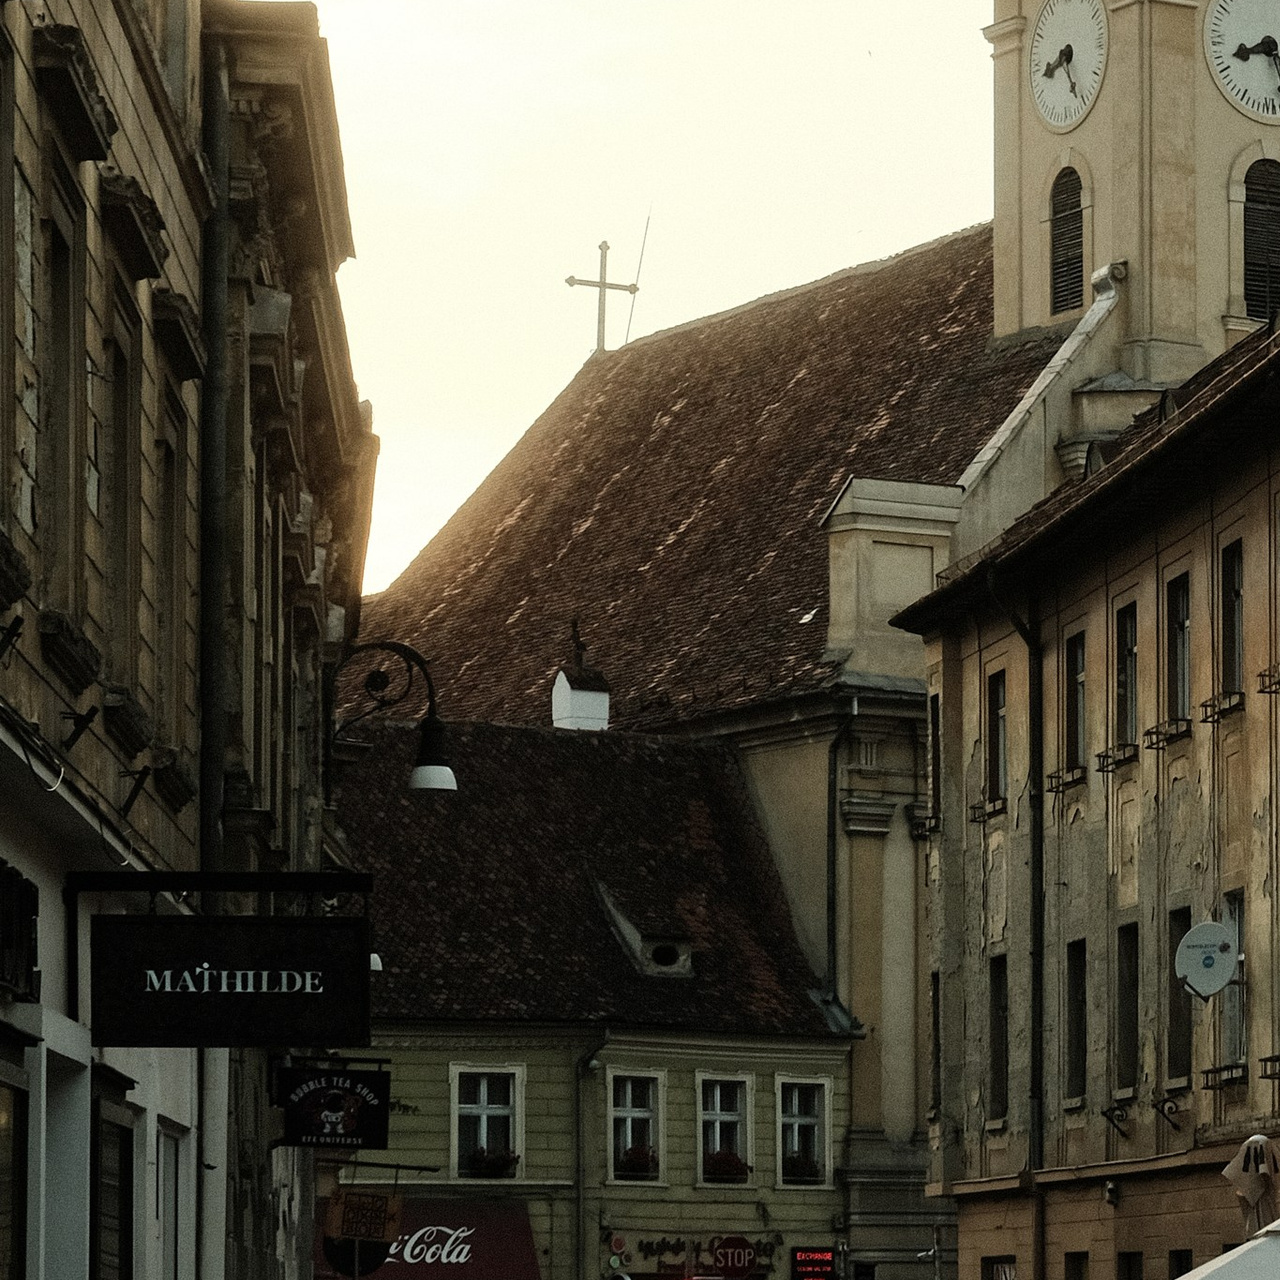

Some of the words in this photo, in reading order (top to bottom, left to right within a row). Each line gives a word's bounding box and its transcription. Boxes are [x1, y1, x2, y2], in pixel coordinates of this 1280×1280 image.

[144, 961, 324, 994] MATHILDE
[290, 1077, 327, 1102] BUBBLE
[332, 1076, 351, 1090] TEA
[354, 1083, 380, 1106] SHOP
[716, 1248, 755, 1268] STOP
